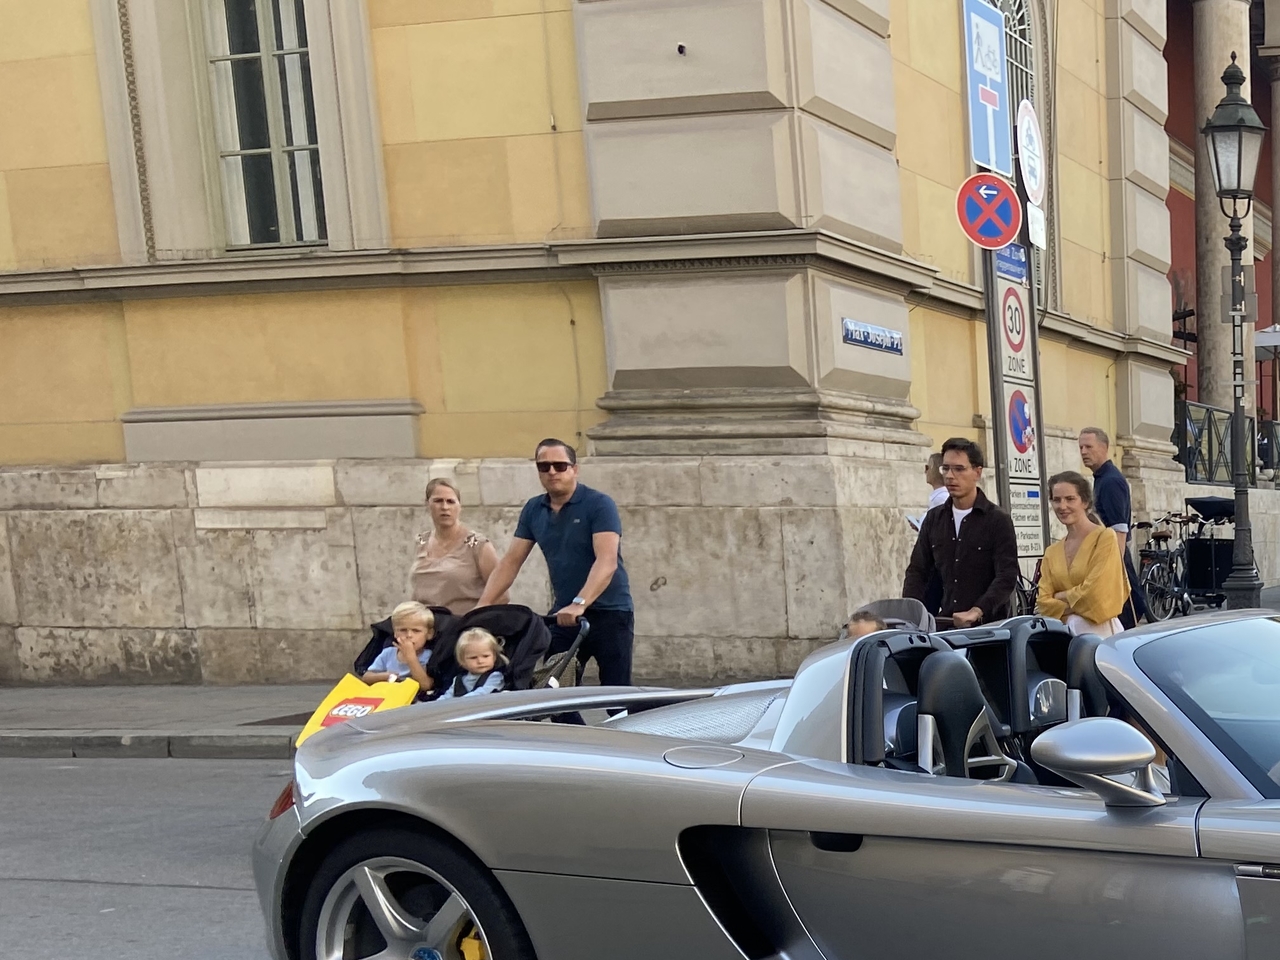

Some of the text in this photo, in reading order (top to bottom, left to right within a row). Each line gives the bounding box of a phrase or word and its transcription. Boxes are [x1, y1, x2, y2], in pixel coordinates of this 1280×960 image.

[1007, 304, 1022, 336] 30
[1007, 355, 1026, 374] ZONE
[1014, 457, 1033, 474] ZONE
[331, 703, 372, 718] LEGO
